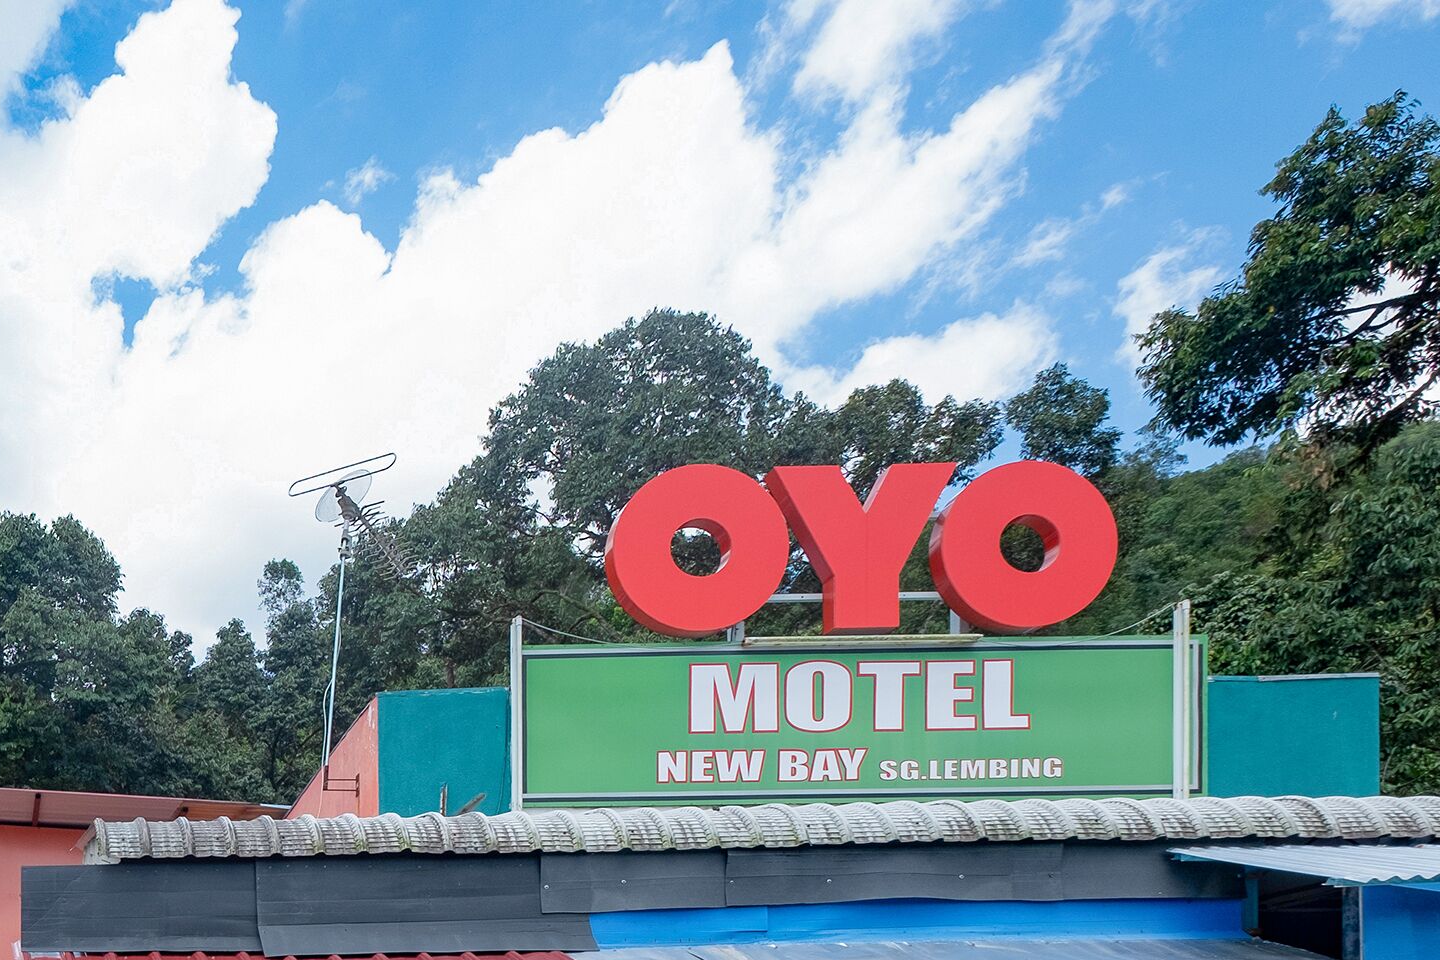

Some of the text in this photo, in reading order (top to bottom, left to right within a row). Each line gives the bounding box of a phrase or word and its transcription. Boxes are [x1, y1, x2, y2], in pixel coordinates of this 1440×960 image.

[604, 459, 1119, 637] OYO
[687, 658, 1031, 735] MOTEL
[656, 747, 1062, 784] NEW BAY SG.LEMBING
